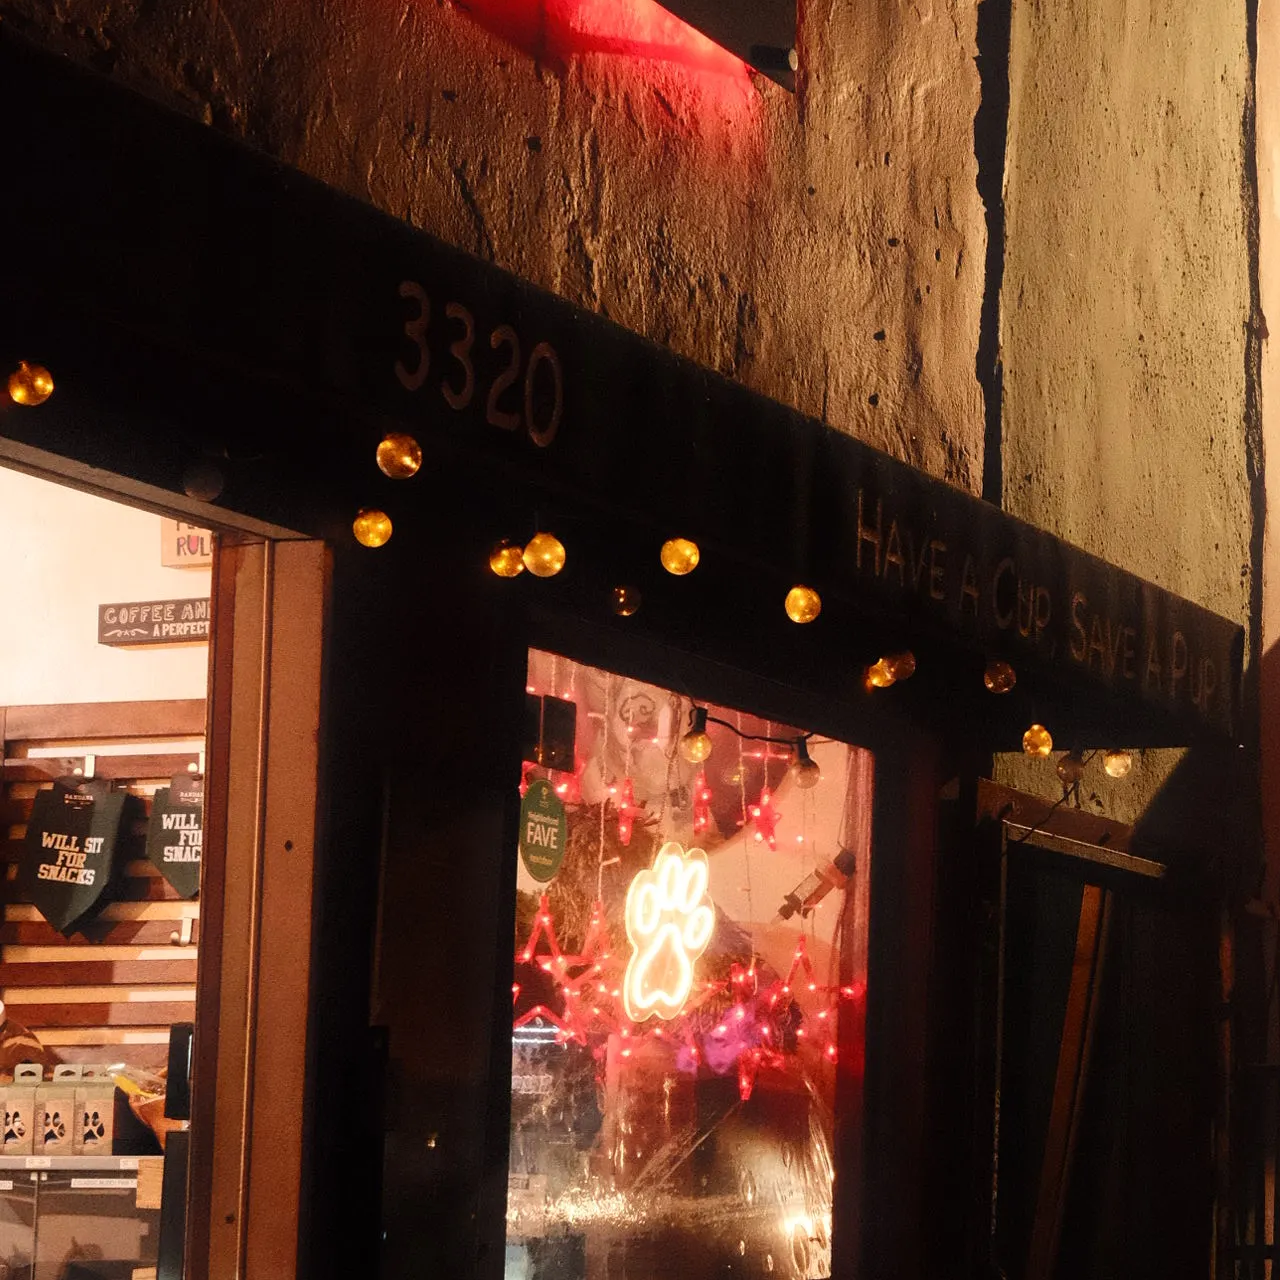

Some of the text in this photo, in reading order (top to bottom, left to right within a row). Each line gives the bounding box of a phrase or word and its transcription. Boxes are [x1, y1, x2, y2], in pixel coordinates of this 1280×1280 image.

[394, 280, 563, 448] 3320
[856, 488, 948, 601] HAVE
[959, 554, 981, 617] A
[1069, 591, 1137, 681] SAVE
[1144, 638, 1163, 690] A
[1169, 631, 1217, 709] PUP
[104, 603, 176, 625] COFFEE
[153, 621, 210, 637] A PERFECT
[162, 814, 198, 830] WILL
[41, 831, 104, 854] WILL SIT
[526, 821, 559, 850] FAVE
[55, 851, 87, 869] FOR
[37, 865, 96, 886] SNACKS
